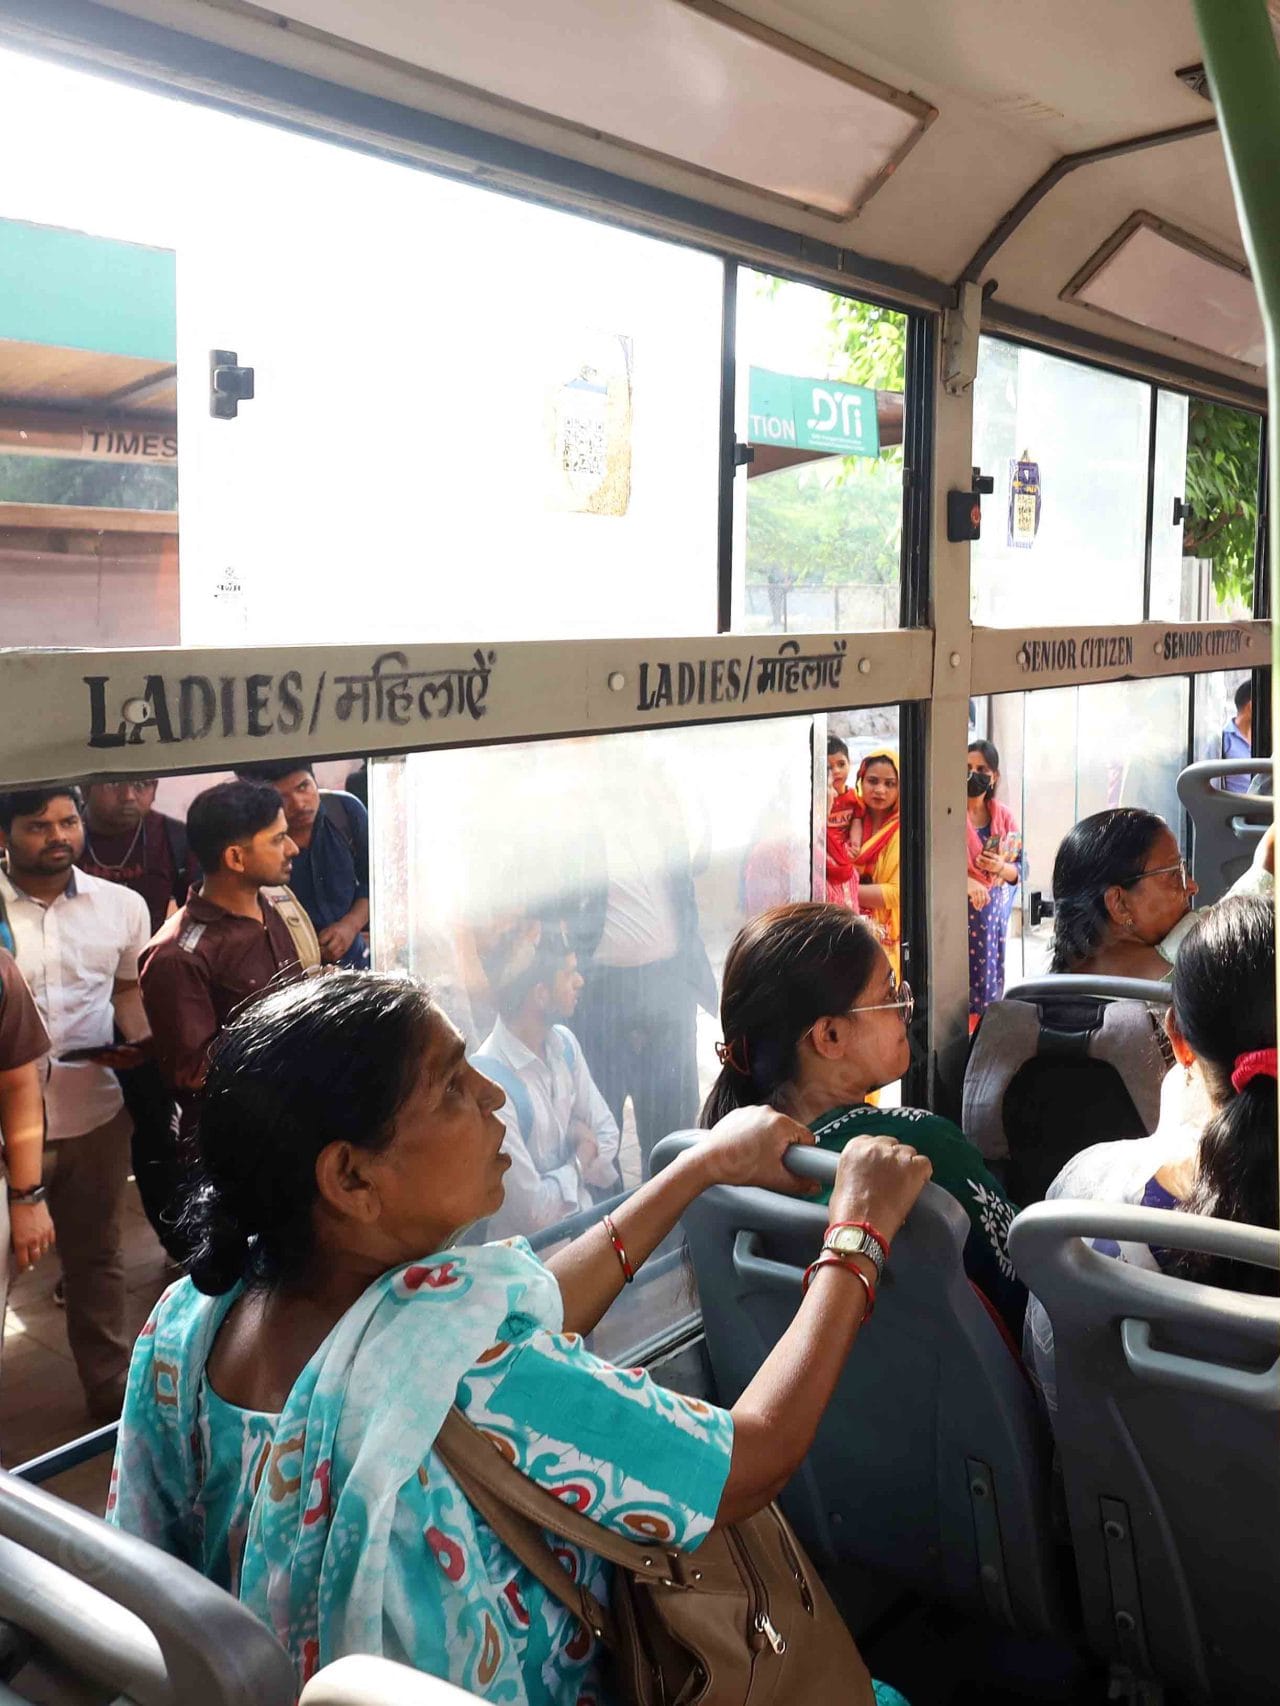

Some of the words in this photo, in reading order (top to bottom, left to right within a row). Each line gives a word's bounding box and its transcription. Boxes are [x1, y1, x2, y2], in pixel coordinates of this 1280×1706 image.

[750, 415, 795, 441] TION
[88, 430, 178, 458] TIMES
[1021, 640, 1077, 673] SENIOR
[1080, 636, 1133, 670] CITIZEN
[1163, 630, 1202, 661] SENIOR
[1204, 629, 1244, 657] CITIZEN
